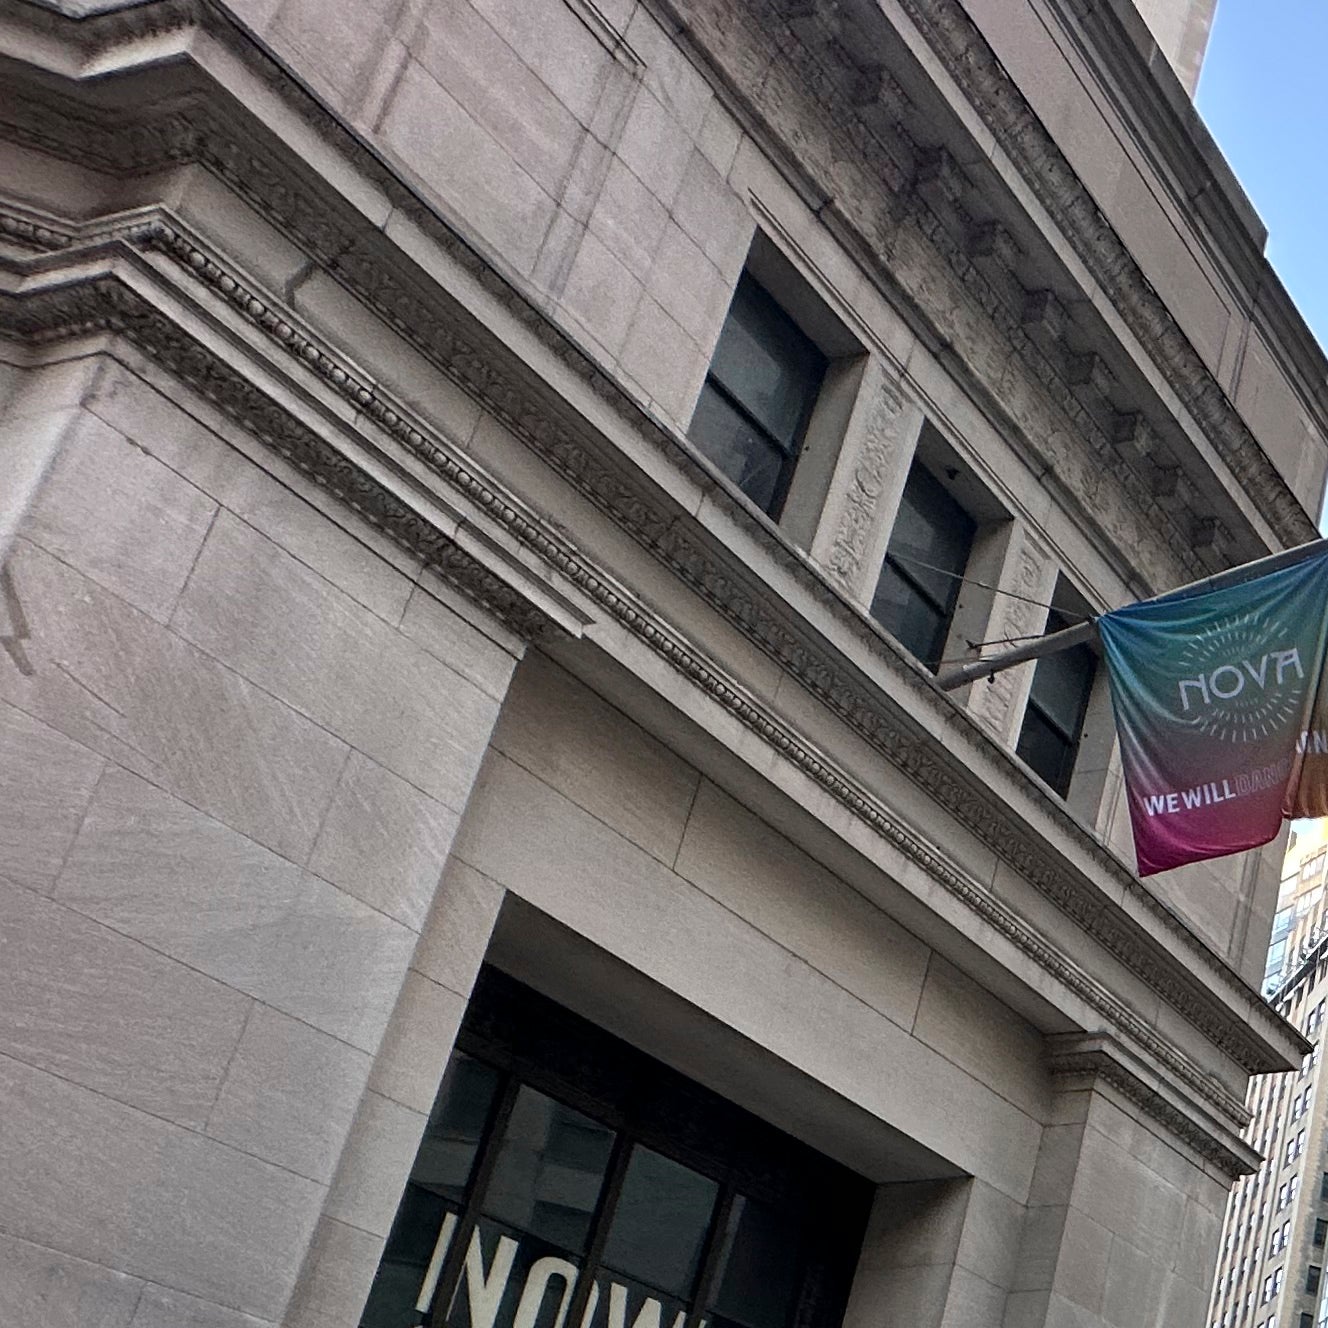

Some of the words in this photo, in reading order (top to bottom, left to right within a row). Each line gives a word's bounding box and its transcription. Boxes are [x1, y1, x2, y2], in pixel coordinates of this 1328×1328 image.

[1178, 648, 1304, 711] NOVA
[1144, 793, 1180, 816] WE
[1181, 779, 1236, 809] WILL
